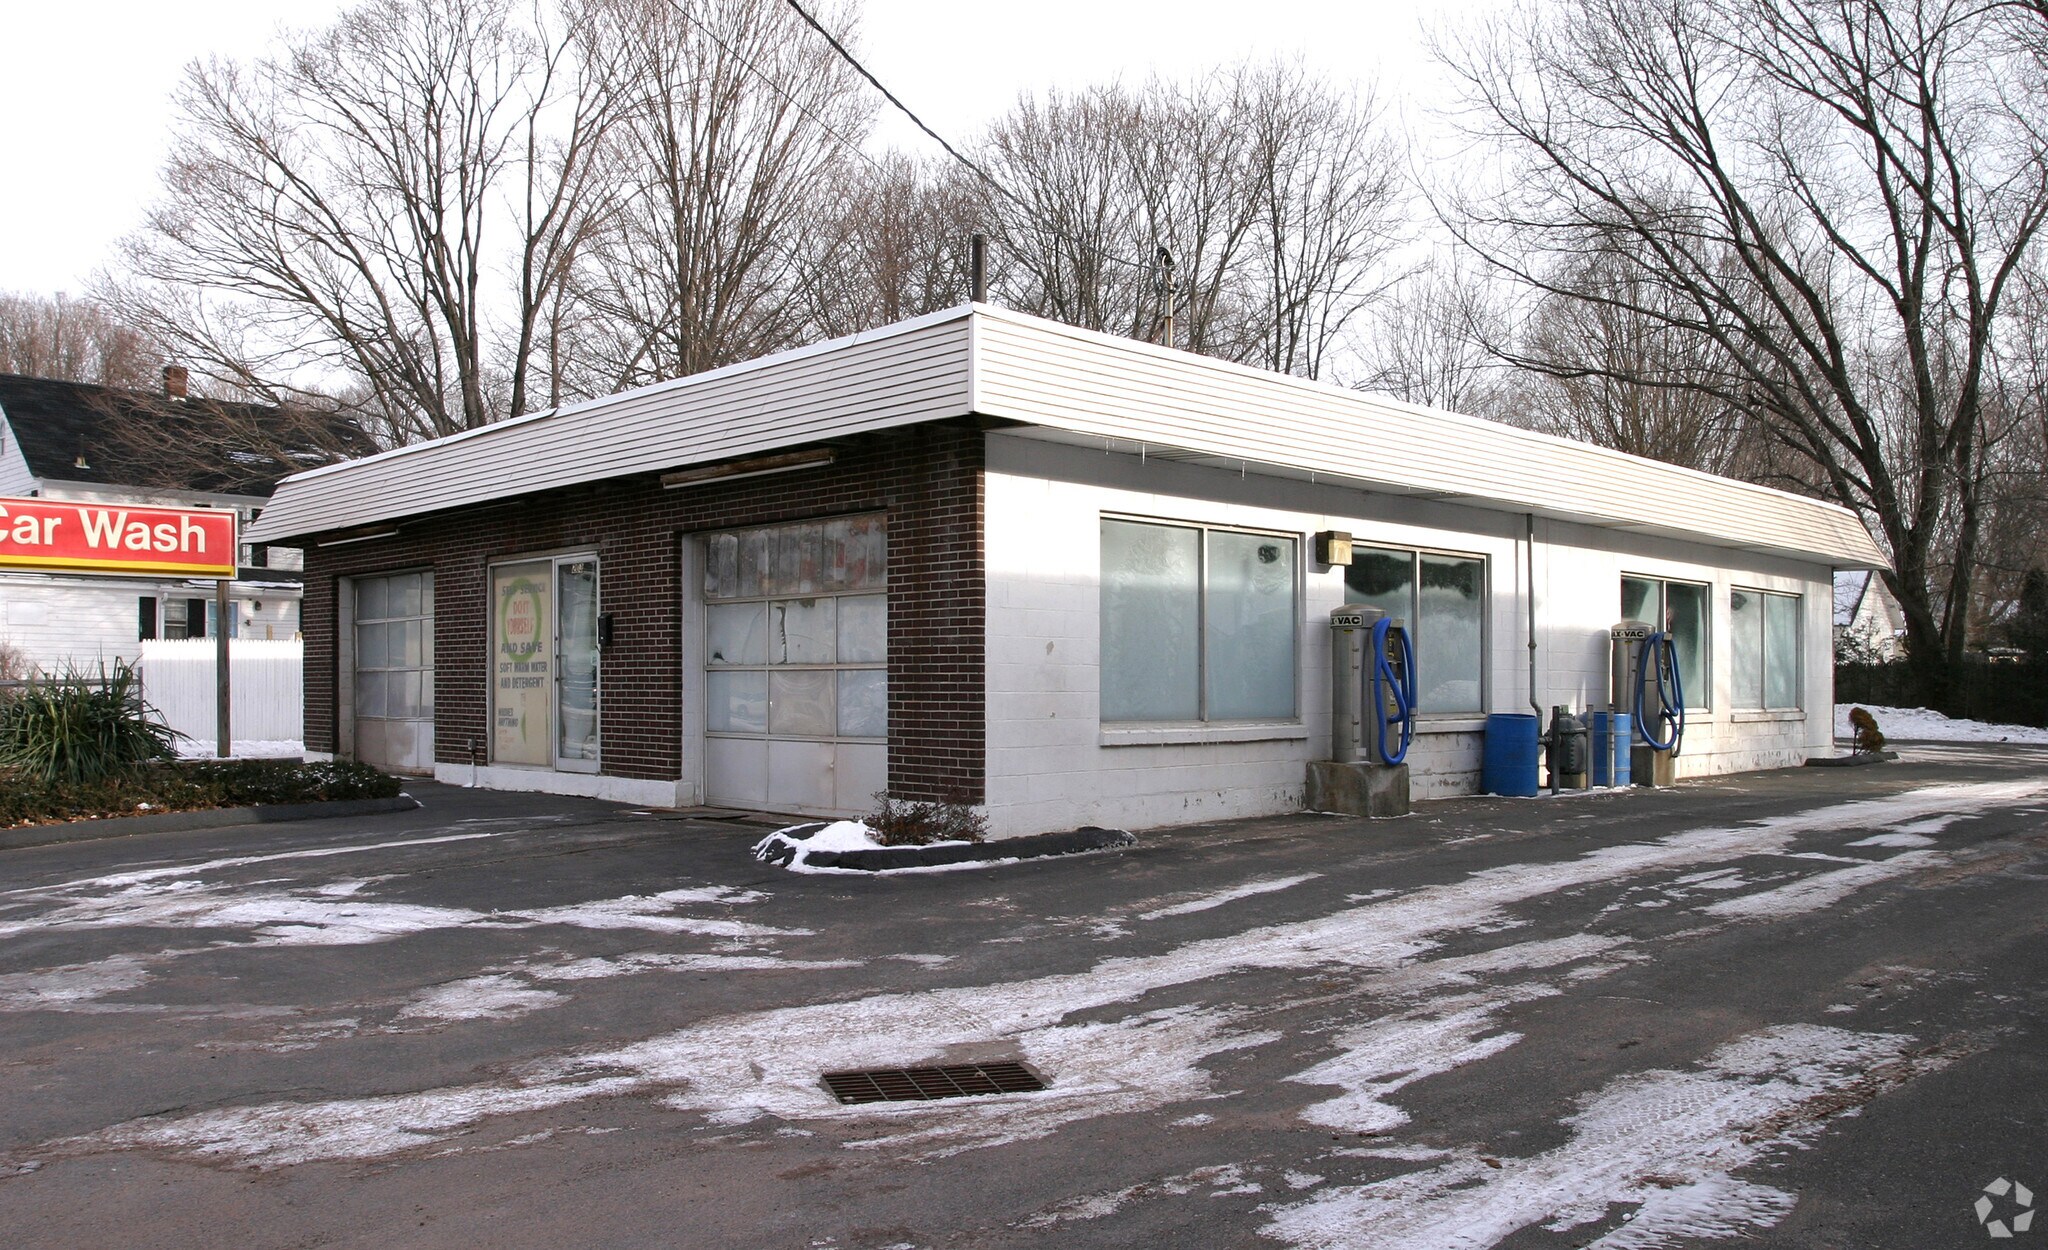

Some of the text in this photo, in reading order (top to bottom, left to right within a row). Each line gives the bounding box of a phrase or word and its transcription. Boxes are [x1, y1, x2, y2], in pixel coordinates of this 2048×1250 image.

[78, 509, 206, 553] Wash
[501, 642, 543, 654] AND SAVE
[500, 662, 513, 673] SOFT
[531, 661, 548, 673] WATER
[500, 676, 544, 688] AND DETERGENT
